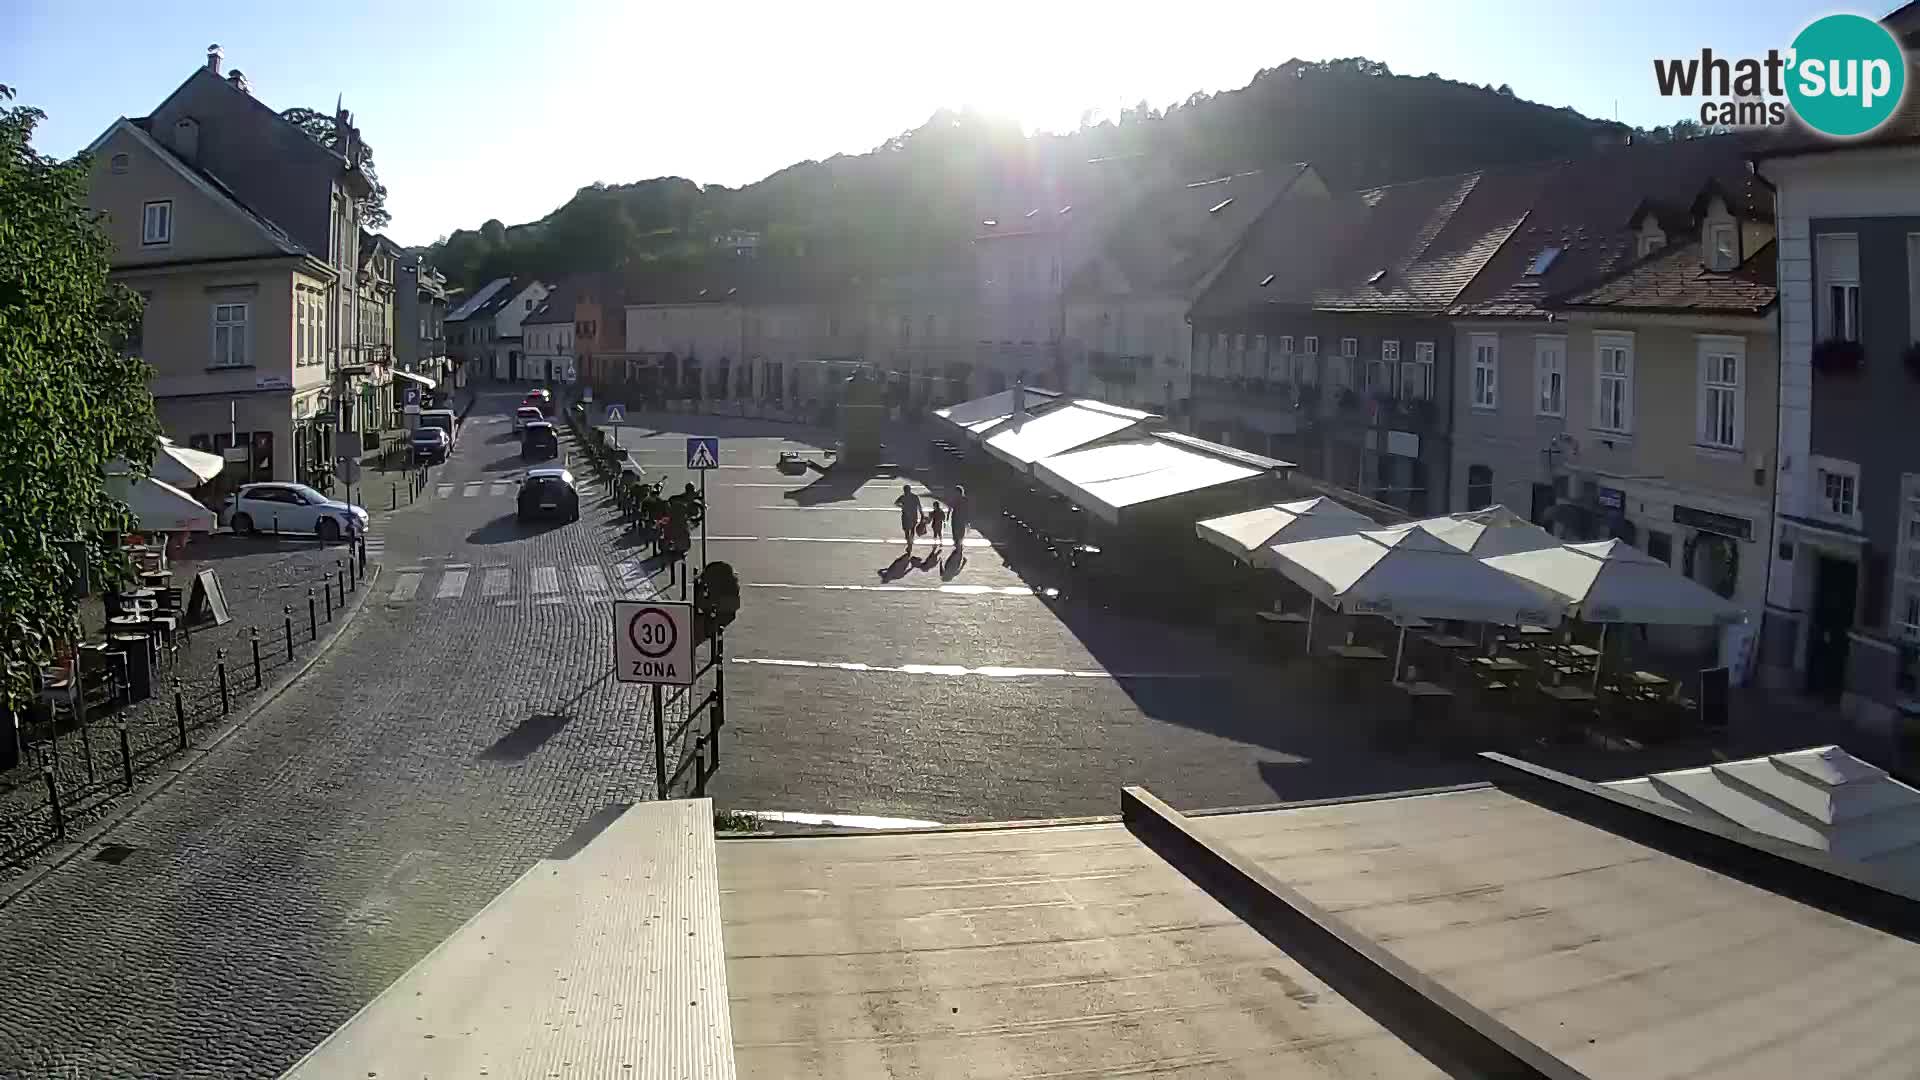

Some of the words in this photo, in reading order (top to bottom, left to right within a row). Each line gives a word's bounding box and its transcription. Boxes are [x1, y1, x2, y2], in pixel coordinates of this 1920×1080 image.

[408, 391, 416, 403] P
[641, 623, 666, 645] 30
[632, 661, 677, 678] ZONA
